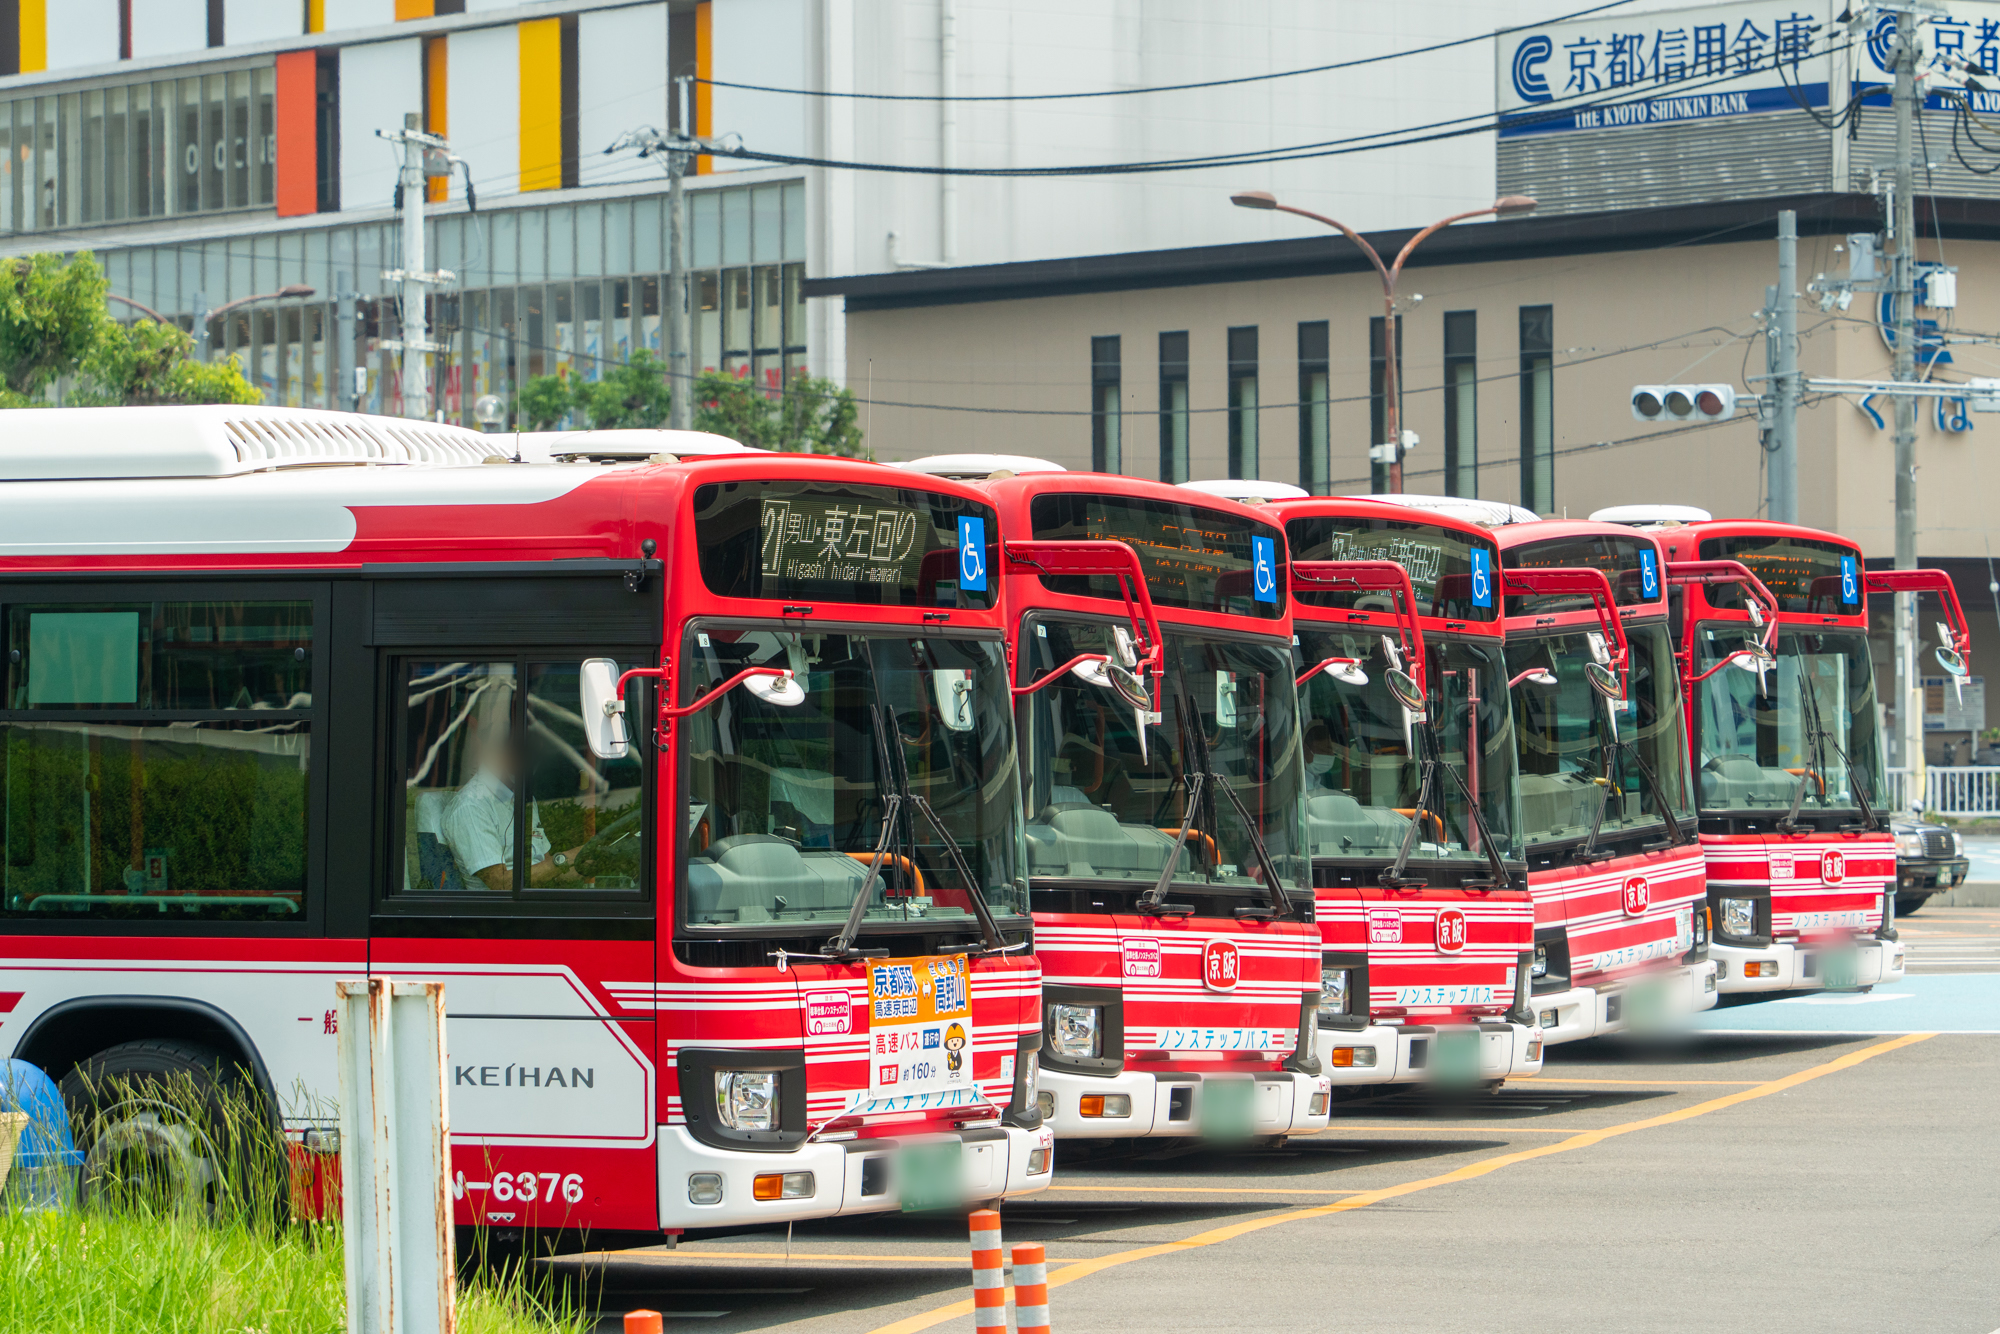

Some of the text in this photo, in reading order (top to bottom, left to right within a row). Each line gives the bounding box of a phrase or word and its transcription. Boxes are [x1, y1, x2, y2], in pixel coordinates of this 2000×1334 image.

[1563, 12, 1814, 93] 京都信用金庫
[1575, 92, 1749, 128] THE KYOTO SHINKIN BANK
[1858, 380, 1974, 432] くは
[787, 558, 903, 583] Higashi hidari-mawari
[1824, 857, 1844, 879] 京阪
[1626, 882, 1648, 909] 京阪
[1439, 917, 1464, 945] 京阪
[1794, 912, 1865, 928] ノンステップバス
[1208, 949, 1236, 981] 京阪
[1595, 939, 1673, 970] ノンステップバス
[873, 966, 918, 998] 京都駅
[934, 973, 967, 1015] 高野山
[1398, 986, 1492, 1004] ノンステップバス
[874, 998, 918, 1020] 高速京田辺
[875, 1031, 919, 1056] 高速バス
[1159, 1029, 1270, 1049] ノンステップバス
[902, 1061, 937, 1082] 約160分
